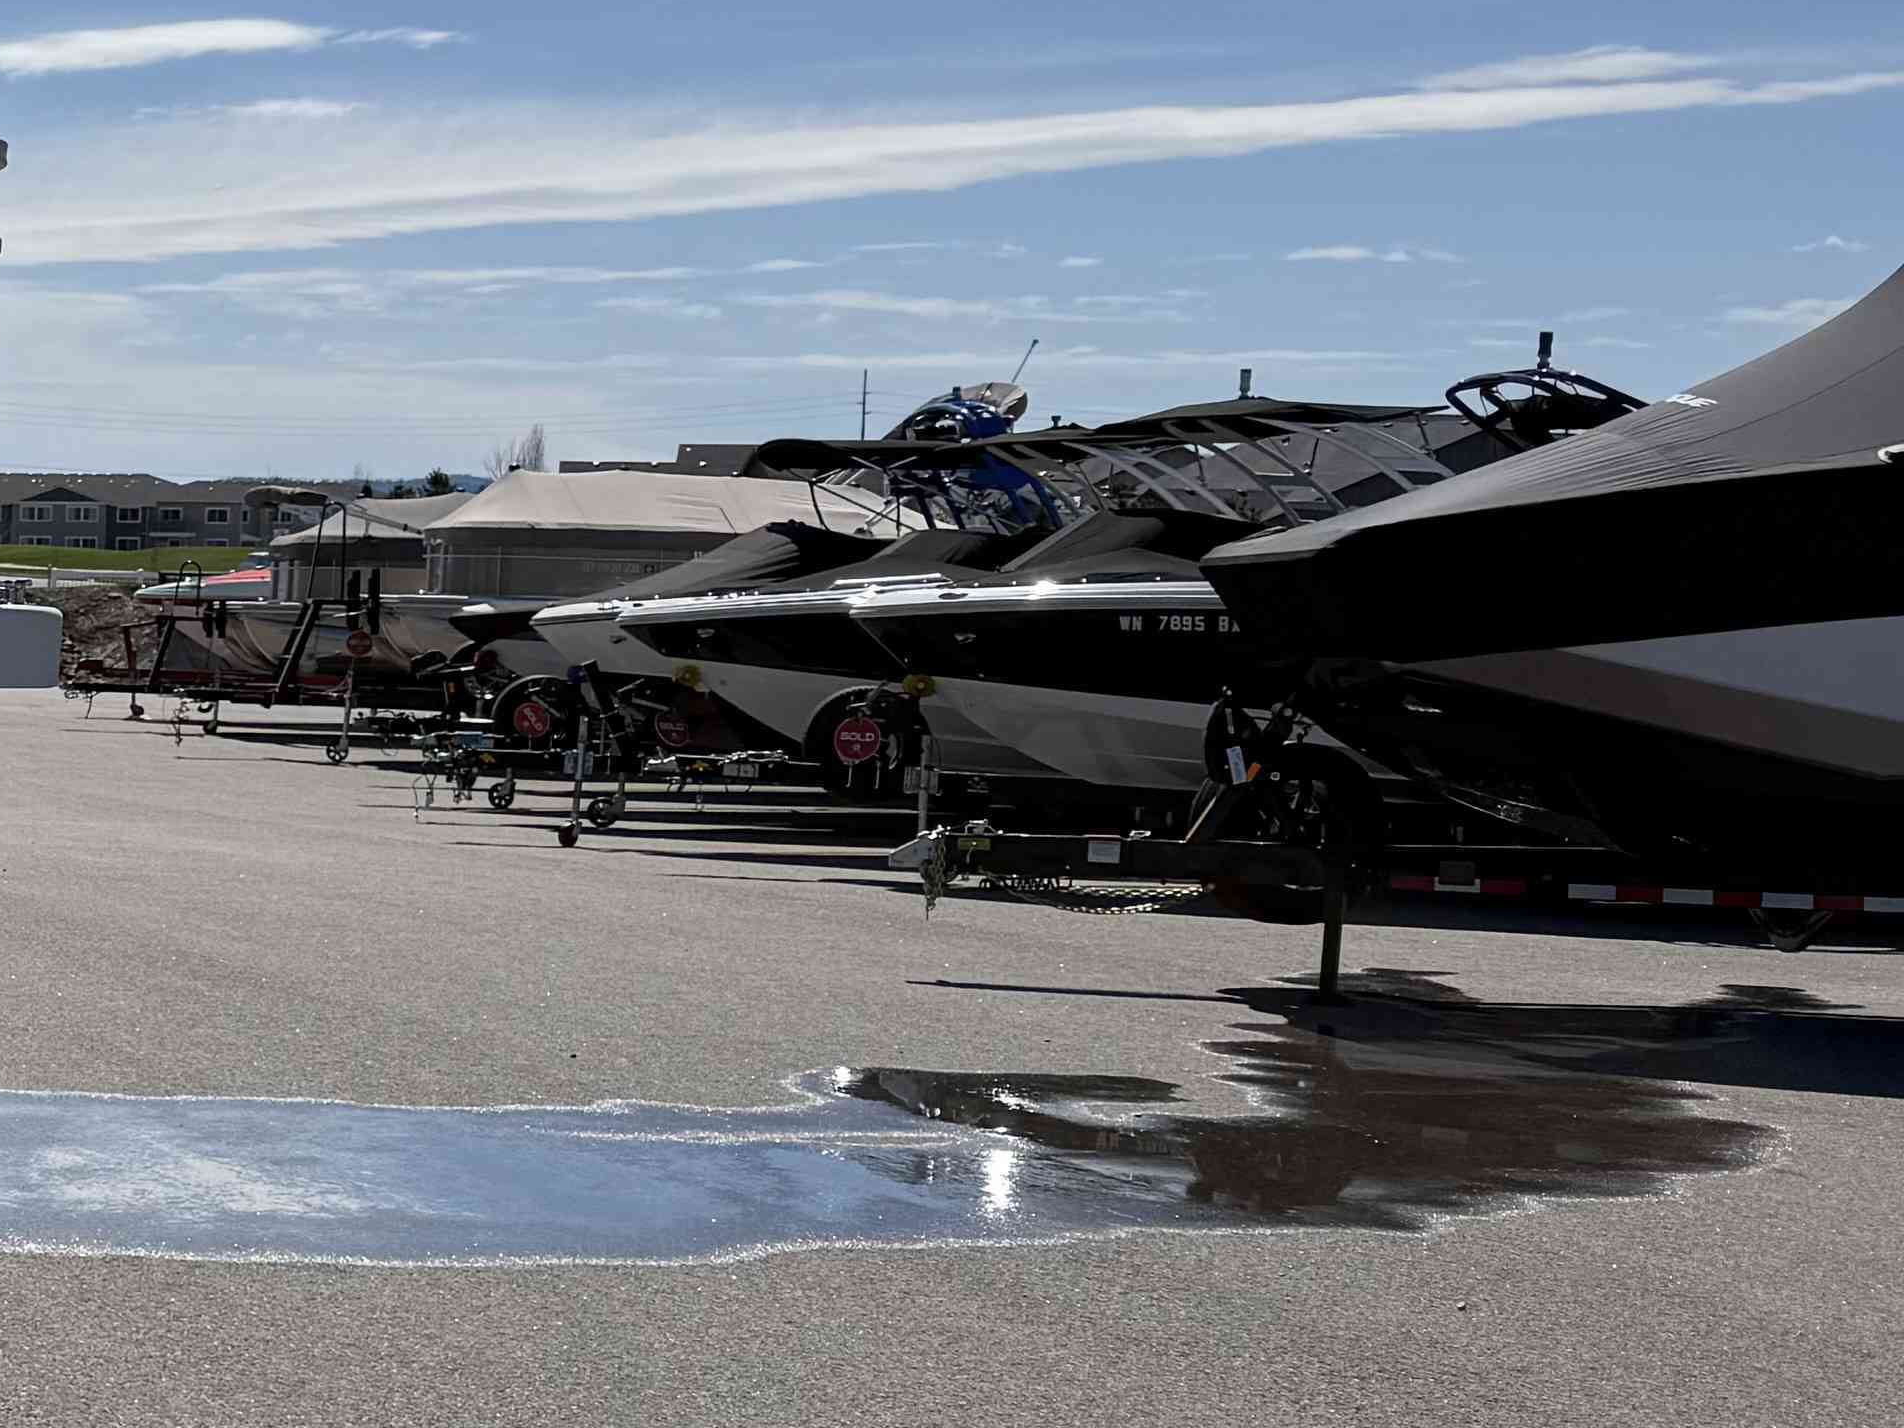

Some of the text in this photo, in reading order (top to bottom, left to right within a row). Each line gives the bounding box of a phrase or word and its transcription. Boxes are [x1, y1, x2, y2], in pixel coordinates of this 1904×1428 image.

[1119, 615, 1143, 632] WN
[1156, 615, 1206, 632] 7895
[839, 731, 875, 742] SOLD
